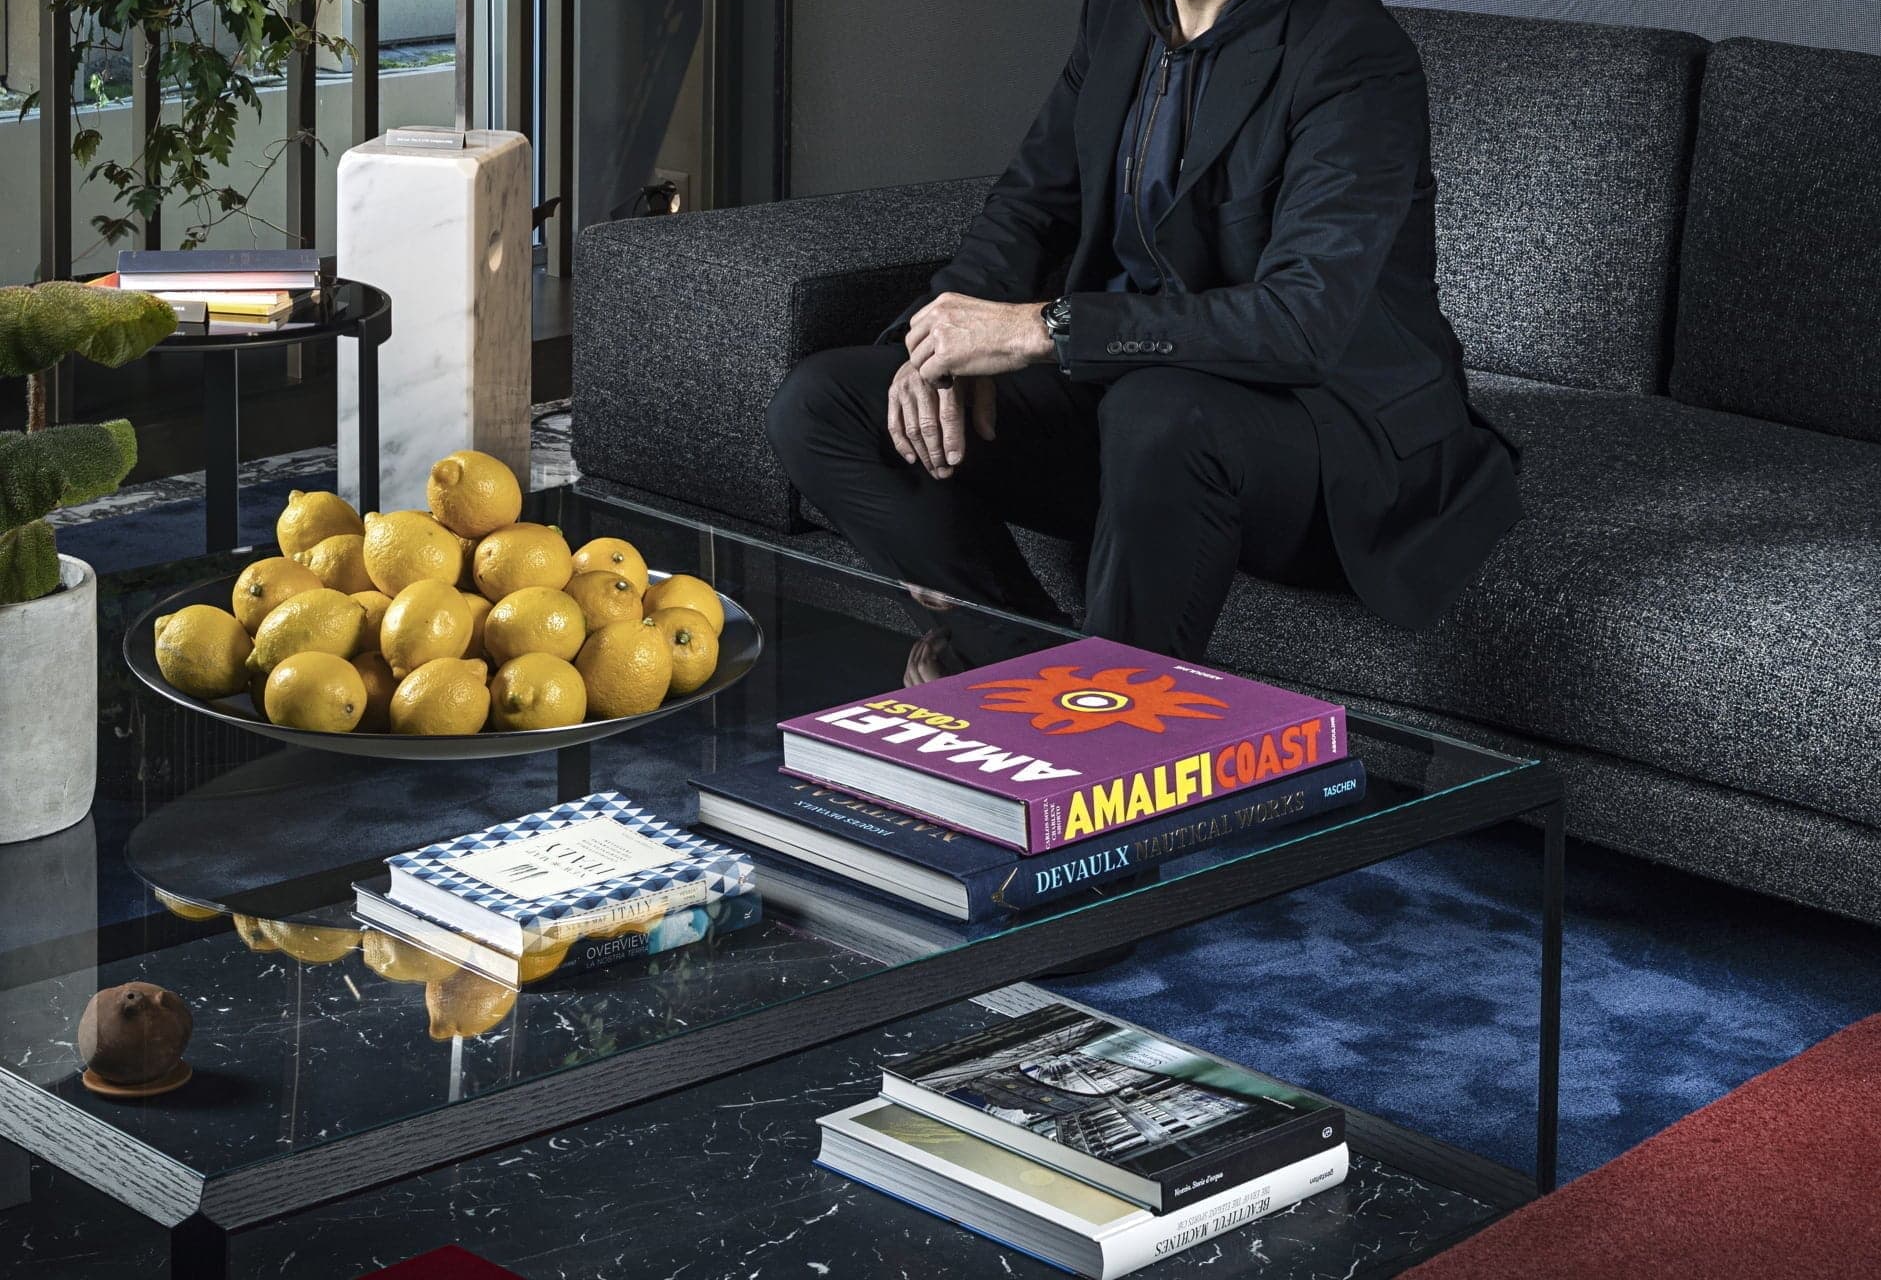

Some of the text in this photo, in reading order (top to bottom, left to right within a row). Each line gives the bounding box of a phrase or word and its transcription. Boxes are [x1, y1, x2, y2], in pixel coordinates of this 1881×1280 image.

[864, 700, 970, 730] COAST
[815, 706, 1083, 782] AMALFI
[1064, 720, 1321, 840] AMALFI COAST
[1323, 778, 1357, 799] TASCHEN
[793, 800, 895, 837] JACQUES DEVAULX
[1036, 791, 1306, 894] DEVAULX NAUTICAL WORKS
[546, 843, 615, 875] ITALY
[611, 900, 651, 920] ITALY
[586, 933, 649, 960] OVERVIEW
[586, 960, 596, 968] LA
[600, 952, 626, 966] NOSTRA
[1309, 1169, 1334, 1185] gestalten
[1154, 1197, 1270, 1257] BEAUTIFUL MACHINES
